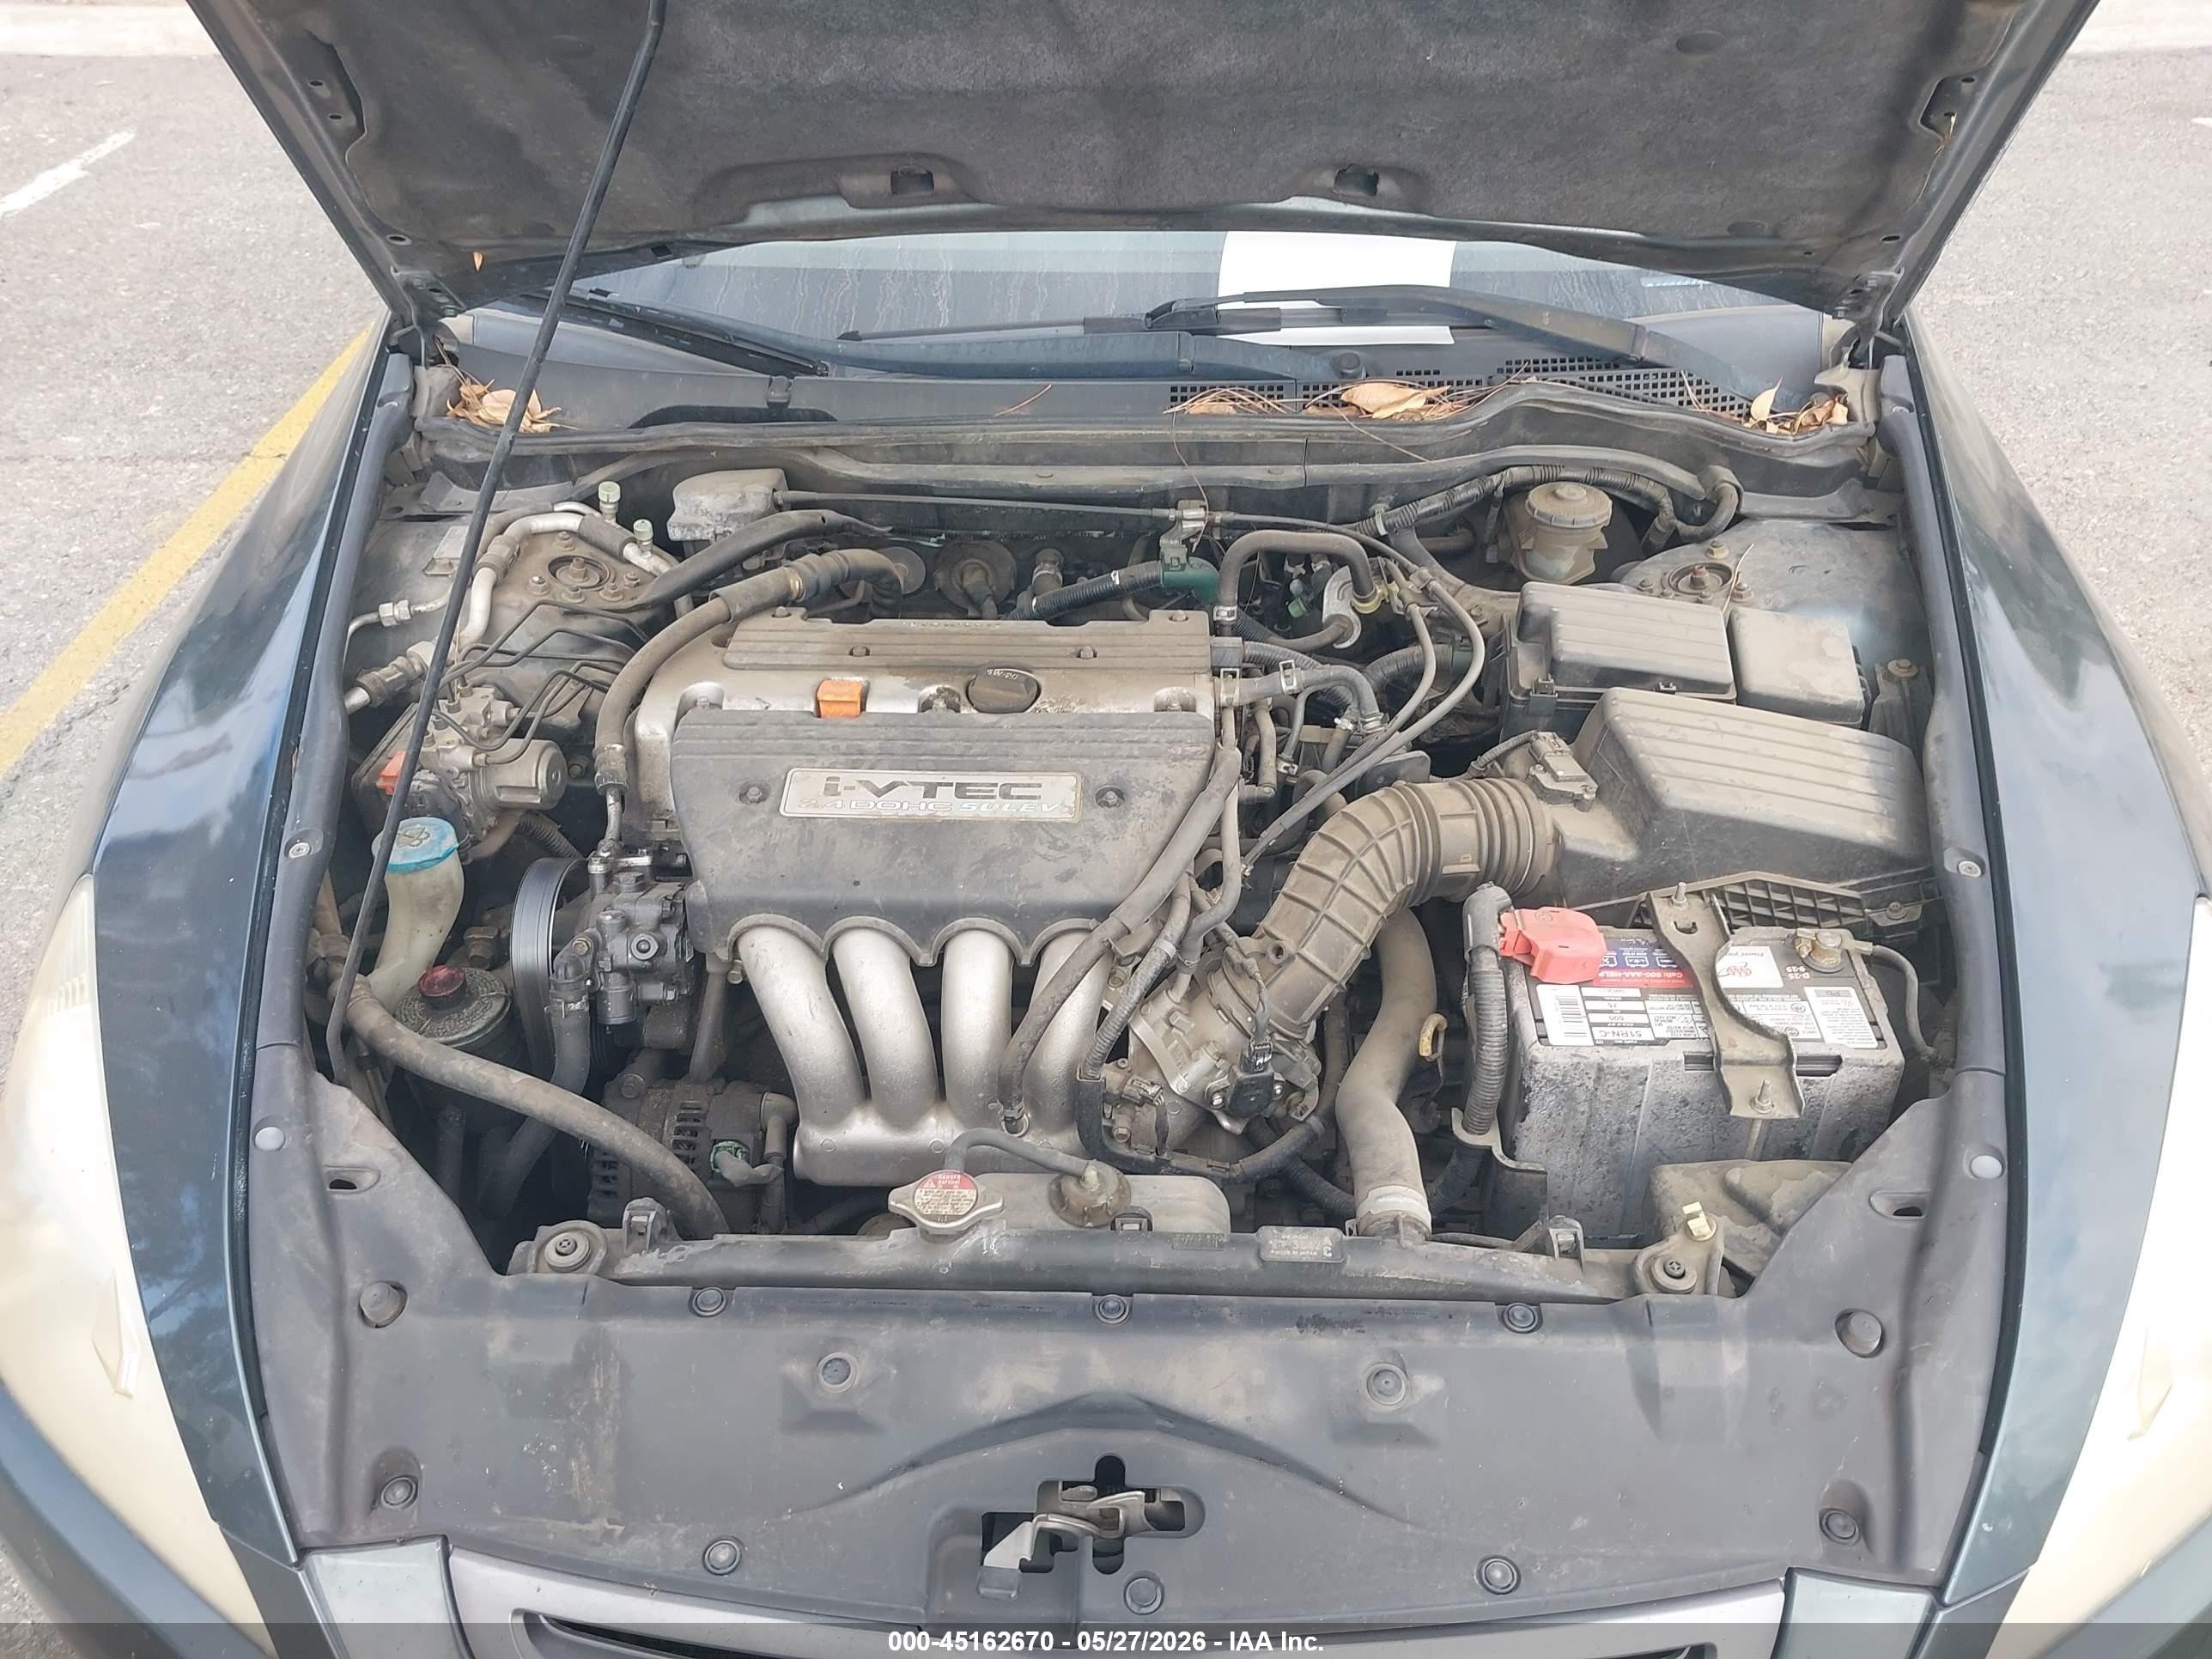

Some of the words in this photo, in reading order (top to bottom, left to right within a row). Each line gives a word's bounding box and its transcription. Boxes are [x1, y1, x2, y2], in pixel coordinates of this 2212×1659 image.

[822, 775, 1042, 800] i-VTEC
[849, 799, 955, 811] DOHC
[959, 802, 1061, 814] SULEV
